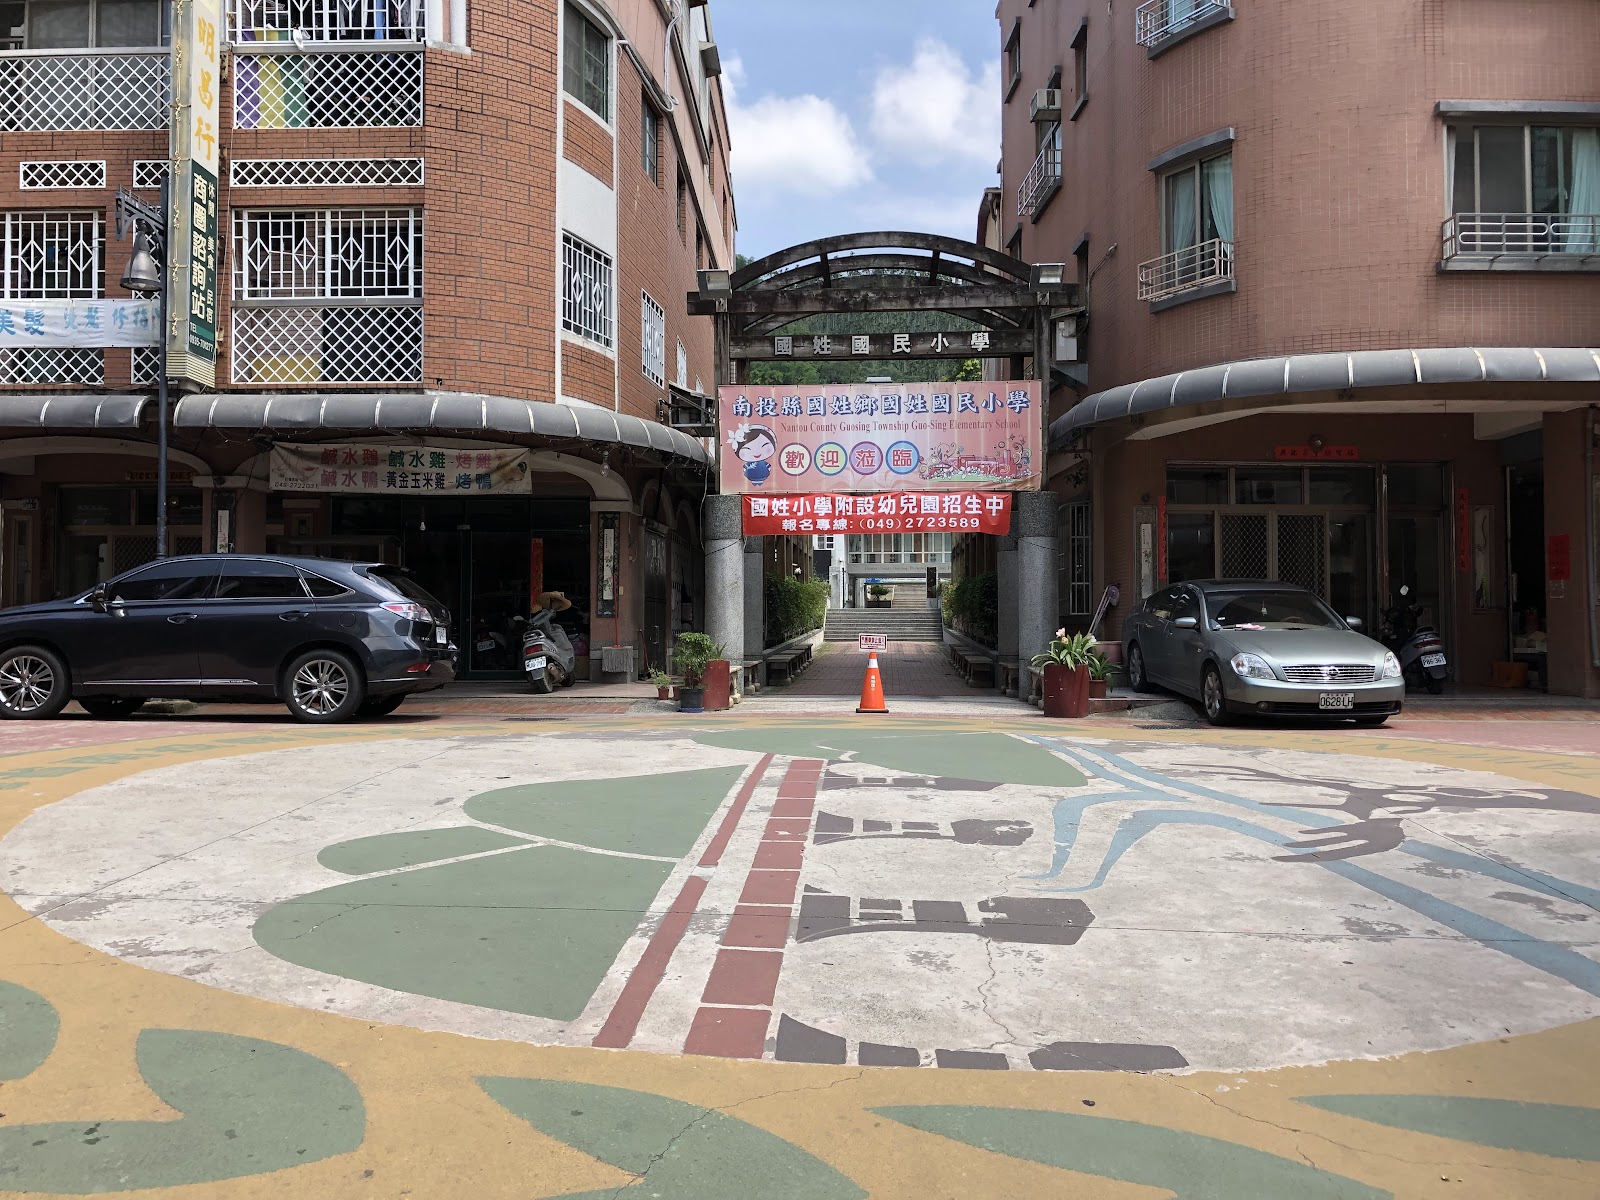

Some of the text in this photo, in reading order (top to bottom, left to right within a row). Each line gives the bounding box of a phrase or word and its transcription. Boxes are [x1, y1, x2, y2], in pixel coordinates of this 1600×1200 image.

[195, 17, 215, 161] 明昌行
[191, 172, 207, 320] 商圈諮詢站
[774, 332, 990, 356] 國姓國民小學
[732, 390, 1031, 417] 南投縣國姓鄉國姓國民小學
[780, 418, 1021, 434] Nantou County Guosing Township Guo-Sing Elementary School
[388, 449, 446, 469] 鹹水雞
[784, 449, 912, 469] 歡迎蒞臨
[320, 469, 378, 488] 鹹水鴨
[455, 473, 492, 490] 烤鴨
[750, 494, 1004, 517] 國姓小學附設幼兒園招生中
